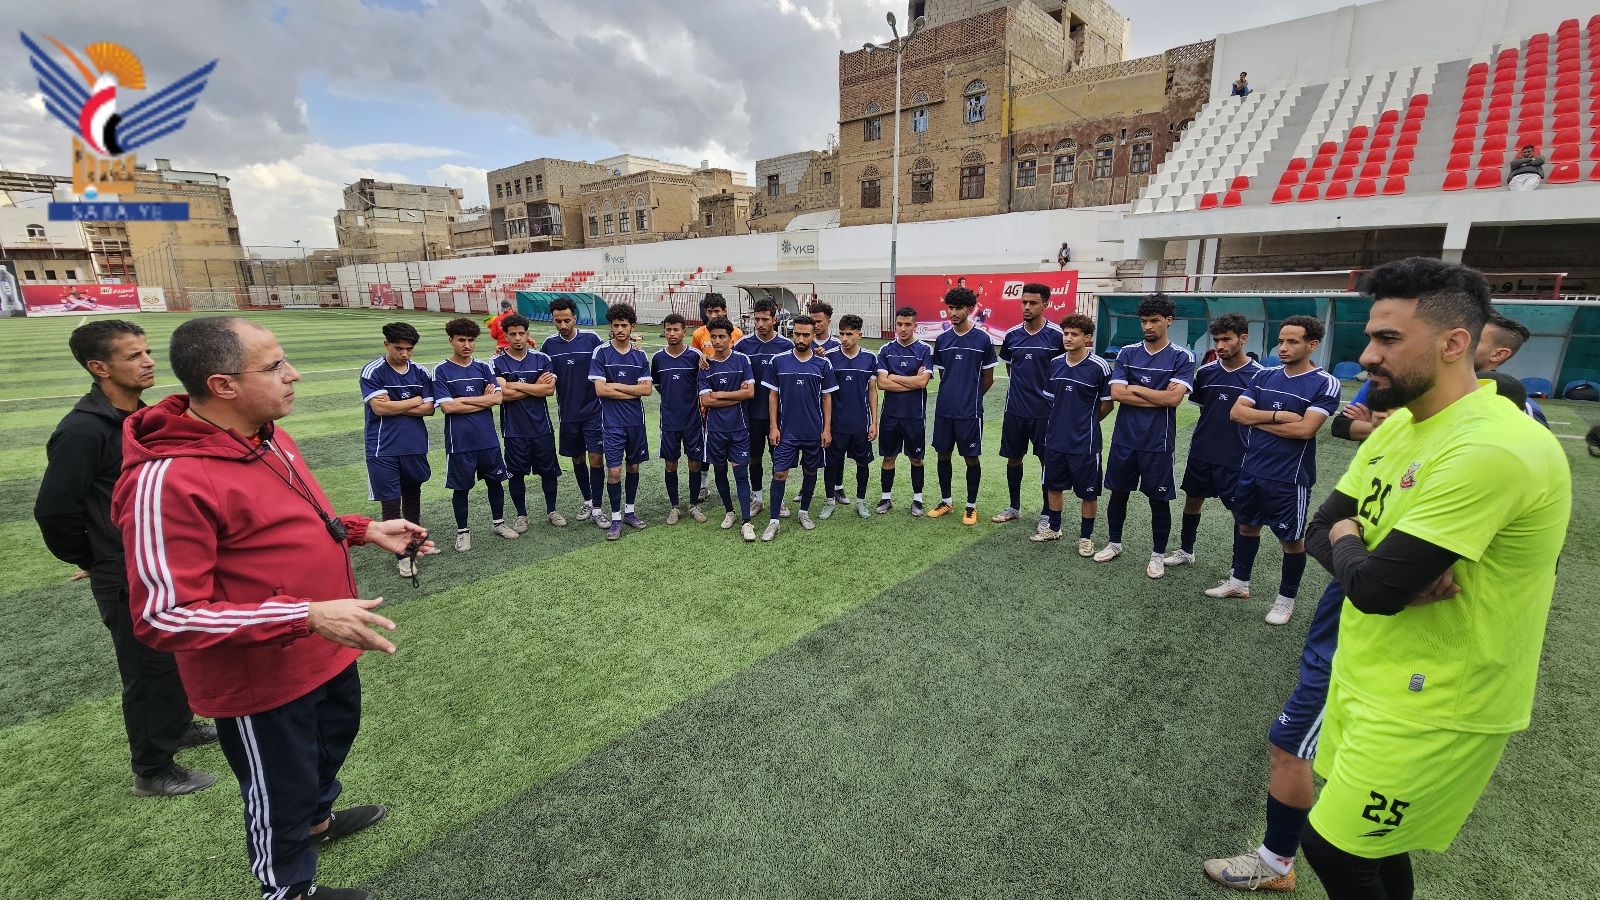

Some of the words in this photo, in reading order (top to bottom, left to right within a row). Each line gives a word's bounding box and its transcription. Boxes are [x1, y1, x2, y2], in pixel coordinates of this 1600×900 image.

[793, 245, 815, 254] YKB
[1004, 284, 1022, 297] 4G
[1359, 477, 1392, 527] 25
[1362, 790, 1411, 827] 25
